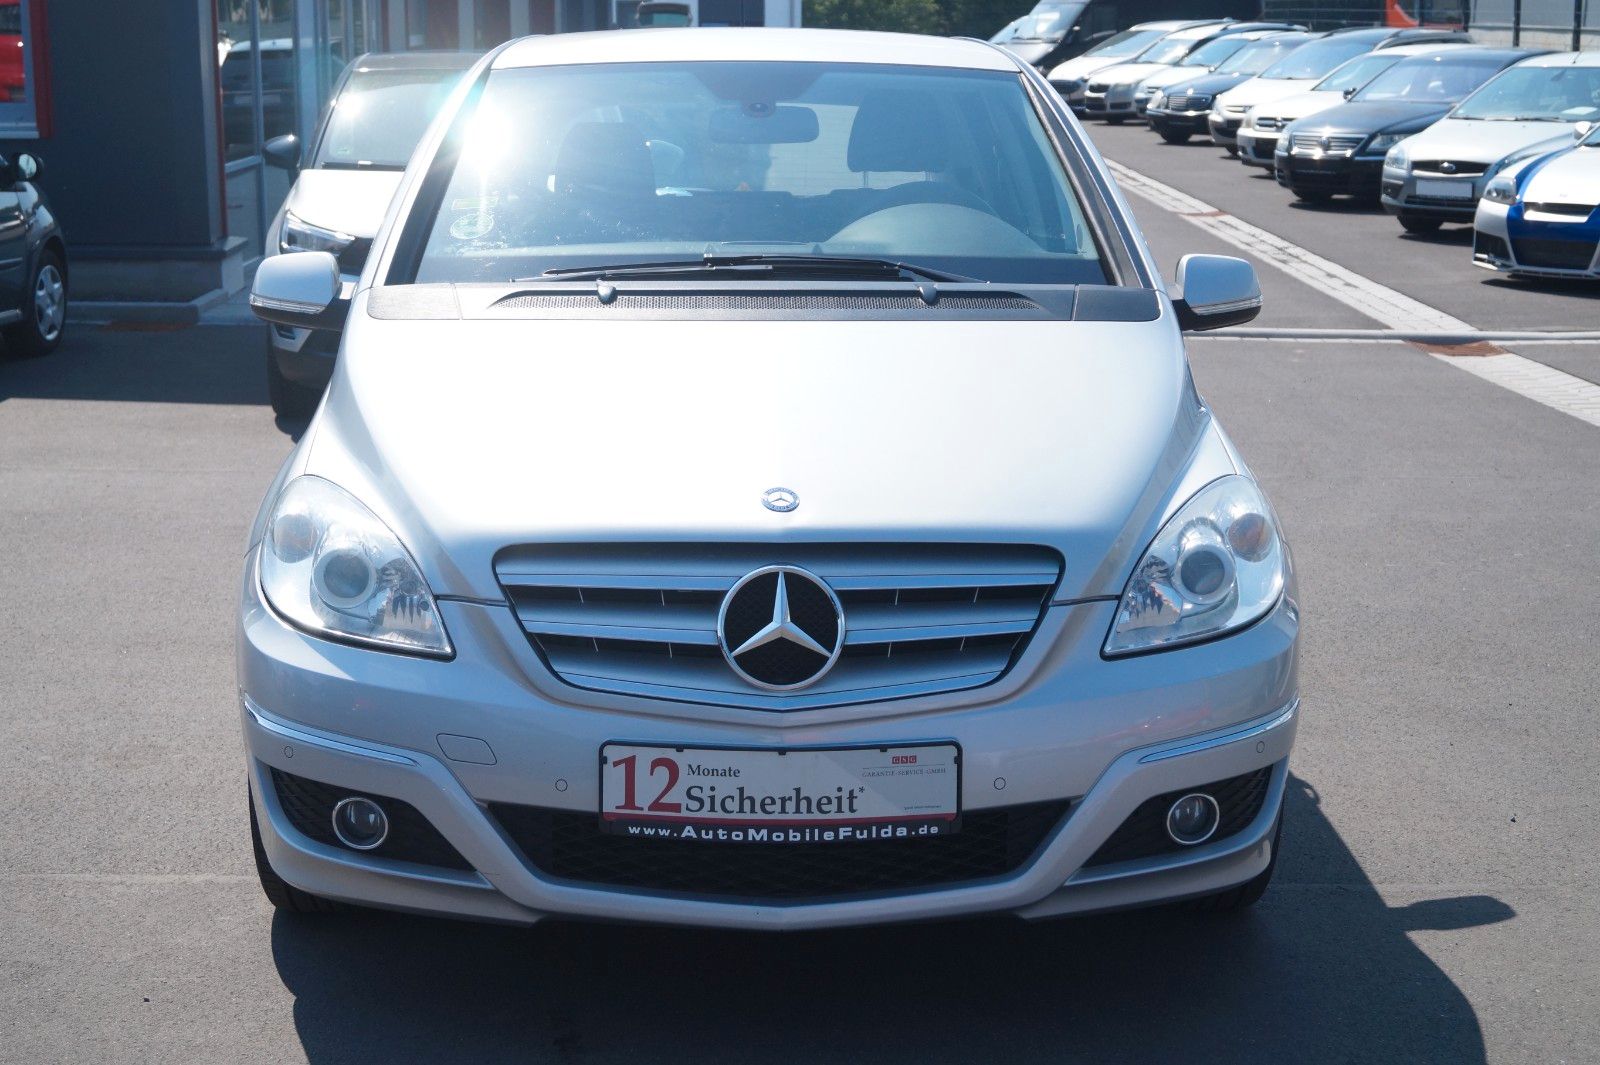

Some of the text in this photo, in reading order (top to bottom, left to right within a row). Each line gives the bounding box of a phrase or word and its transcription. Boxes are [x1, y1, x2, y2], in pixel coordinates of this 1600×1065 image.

[687, 763, 741, 778] Monate
[612, 755, 682, 813] 12
[628, 824, 939, 843] www.AutoMobileFulda.de
